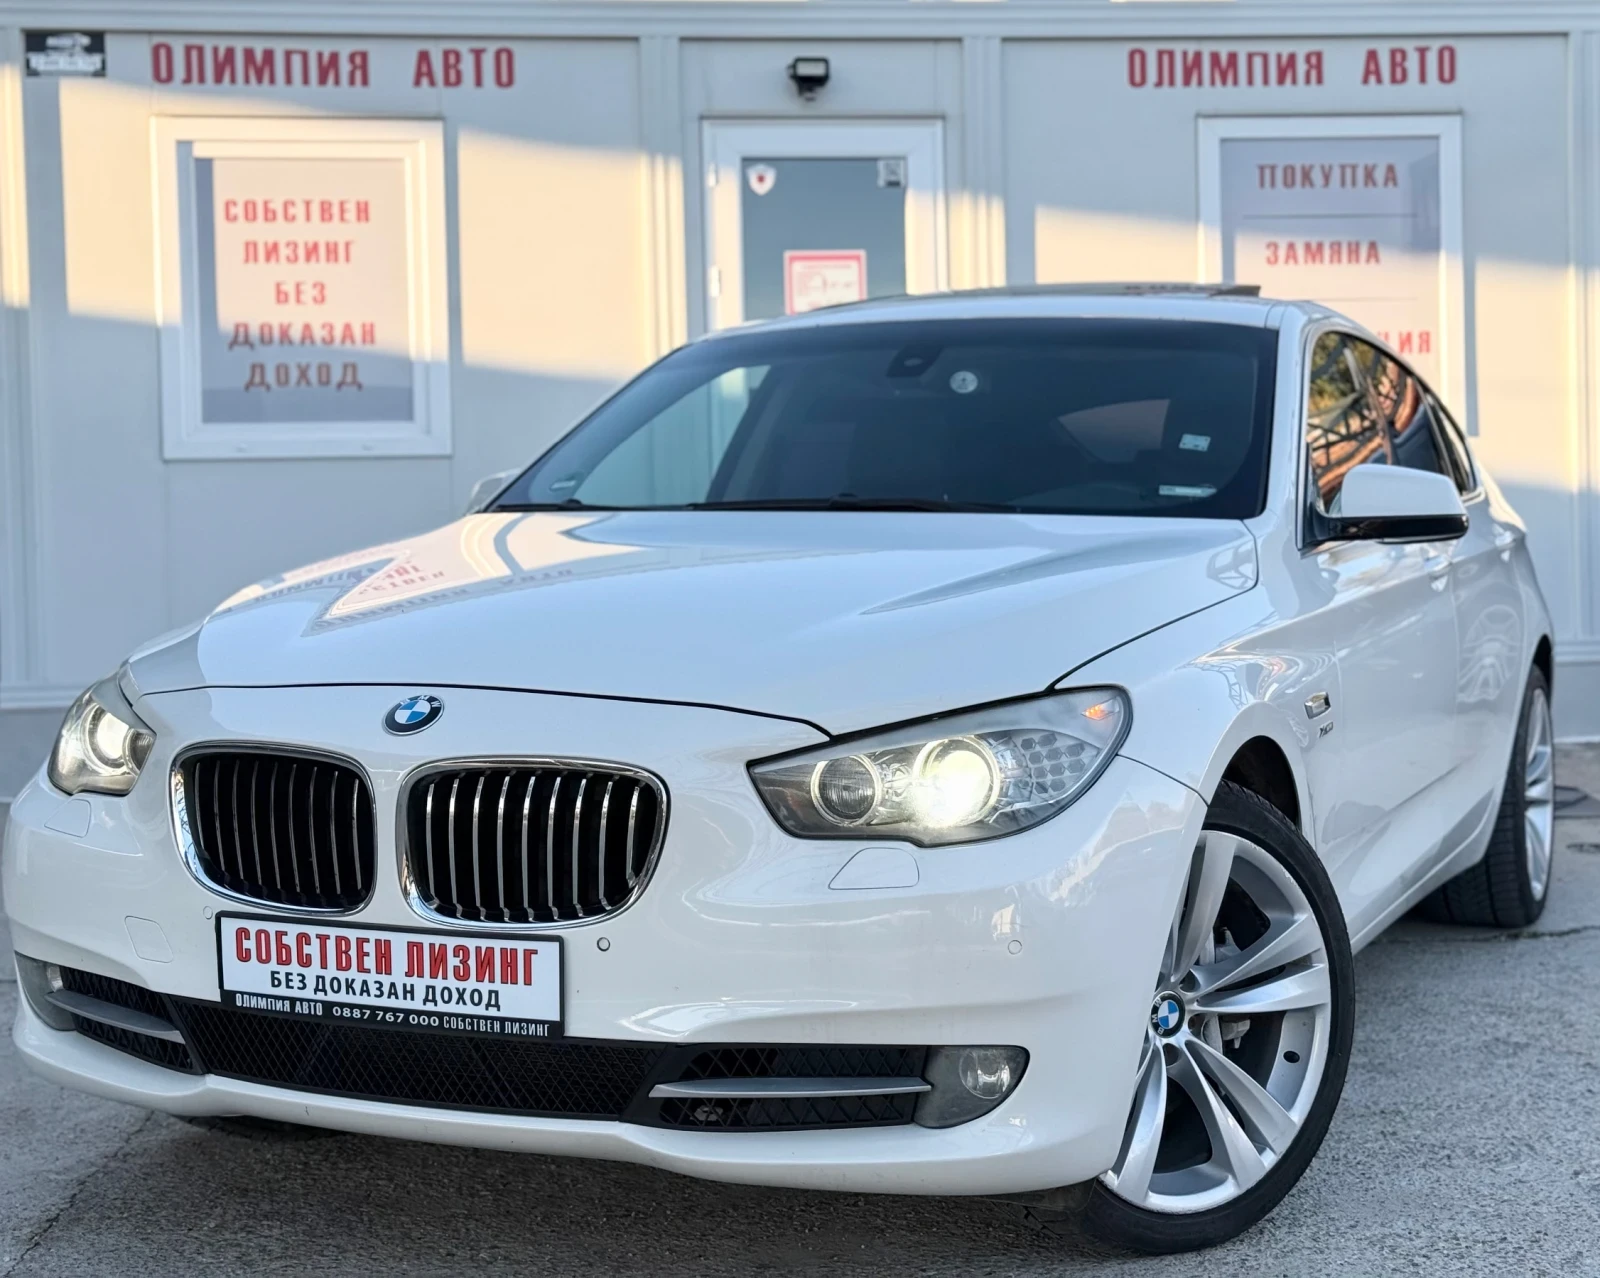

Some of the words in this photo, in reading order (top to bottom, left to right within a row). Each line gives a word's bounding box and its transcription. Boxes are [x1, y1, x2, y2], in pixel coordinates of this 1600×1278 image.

[151, 42, 370, 88] ОЛИМПИЯ
[412, 47, 515, 88] АВТО
[1128, 48, 1325, 88] ОЛИМПИЯ
[1360, 45, 1458, 86] АВТО
[1257, 163, 1398, 189] ПОКУПКА
[224, 199, 371, 223] СОБСТВЕН
[243, 240, 355, 264] ЛИЗИНГ
[1265, 240, 1381, 266] ЗАМЯНА
[275, 281, 327, 305] БЕЗ
[229, 321, 377, 350] ДОКАЗАН
[244, 362, 363, 391] ДОХОД
[235, 927, 393, 976] СОБСТВЕН
[404, 940, 539, 986] ЛИЗИНГ
[270, 970, 308, 991] БЕЗ
[313, 975, 416, 1002] ДОКАЗАН
[422, 984, 501, 1012] ДОХОД
[235, 993, 291, 1013] ОЛИМПИЯ
[294, 1002, 323, 1016] АВТО
[332, 1006, 371, 1020] 0887
[375, 1010, 404, 1023] 767
[409, 1014, 440, 1026] 000
[443, 1016, 501, 1033] СОБСТВЕН
[504, 1021, 550, 1037] ЛИЗИНГ
